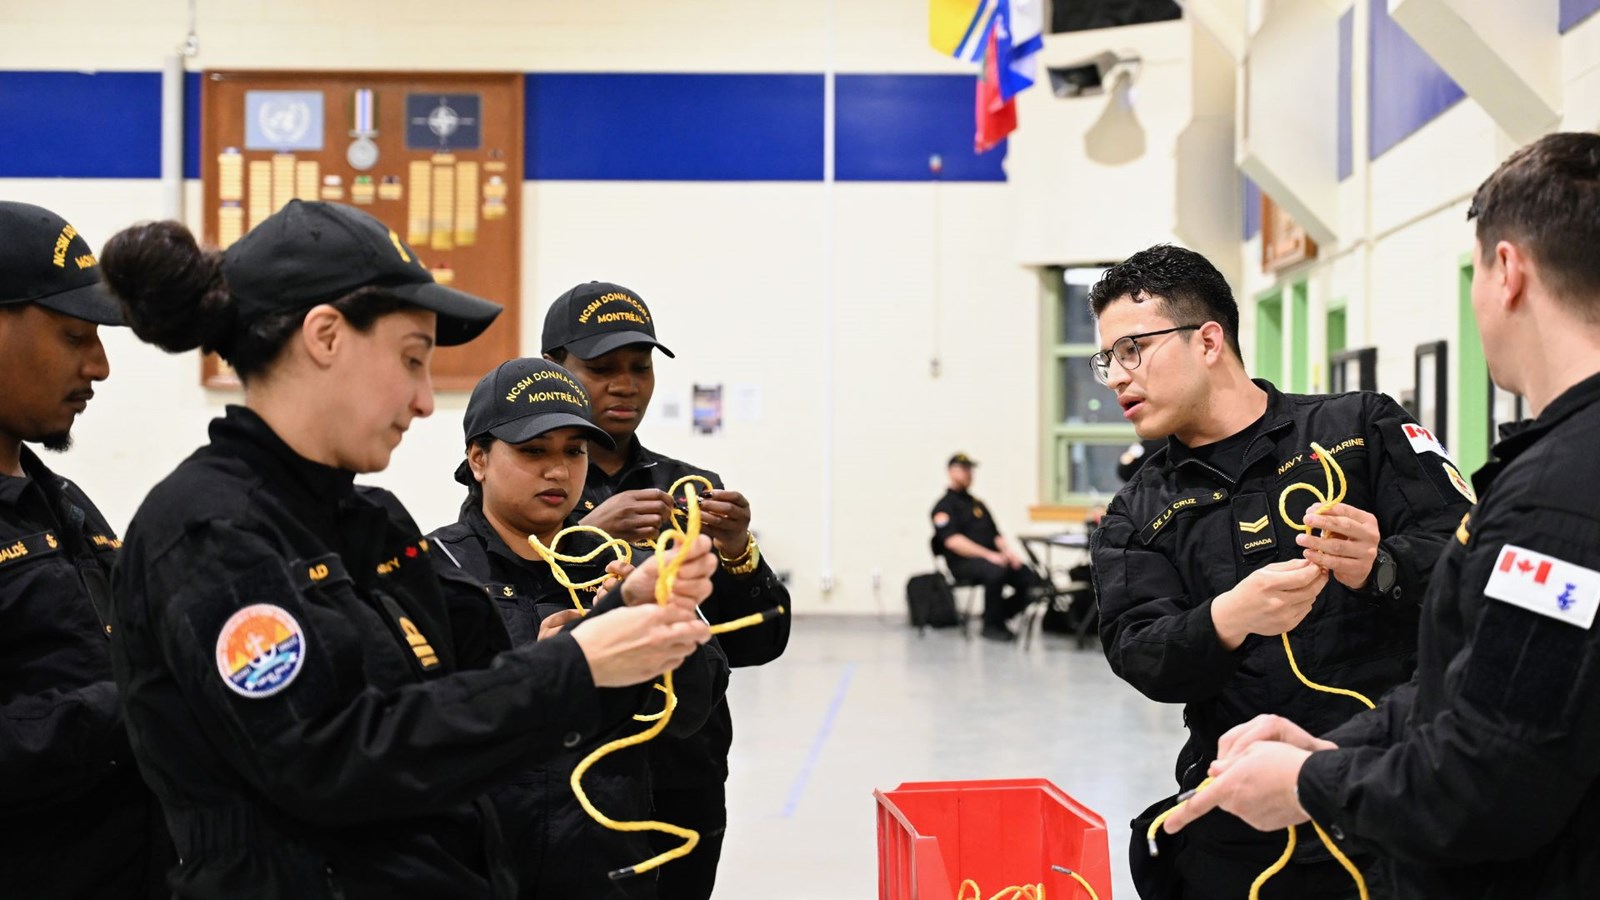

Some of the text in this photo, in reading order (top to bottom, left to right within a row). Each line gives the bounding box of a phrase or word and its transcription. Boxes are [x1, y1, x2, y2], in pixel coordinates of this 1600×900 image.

[579, 299, 602, 324] NCSM
[597, 311, 645, 324] MONTRÉAL
[506, 377, 533, 402] NCSM
[528, 391, 582, 407] MONTRÉAL
[1278, 438, 1364, 475] NAVY MARINE
[1153, 498, 1197, 530] DE LA CRUZ
[1244, 538, 1272, 550] CANADA
